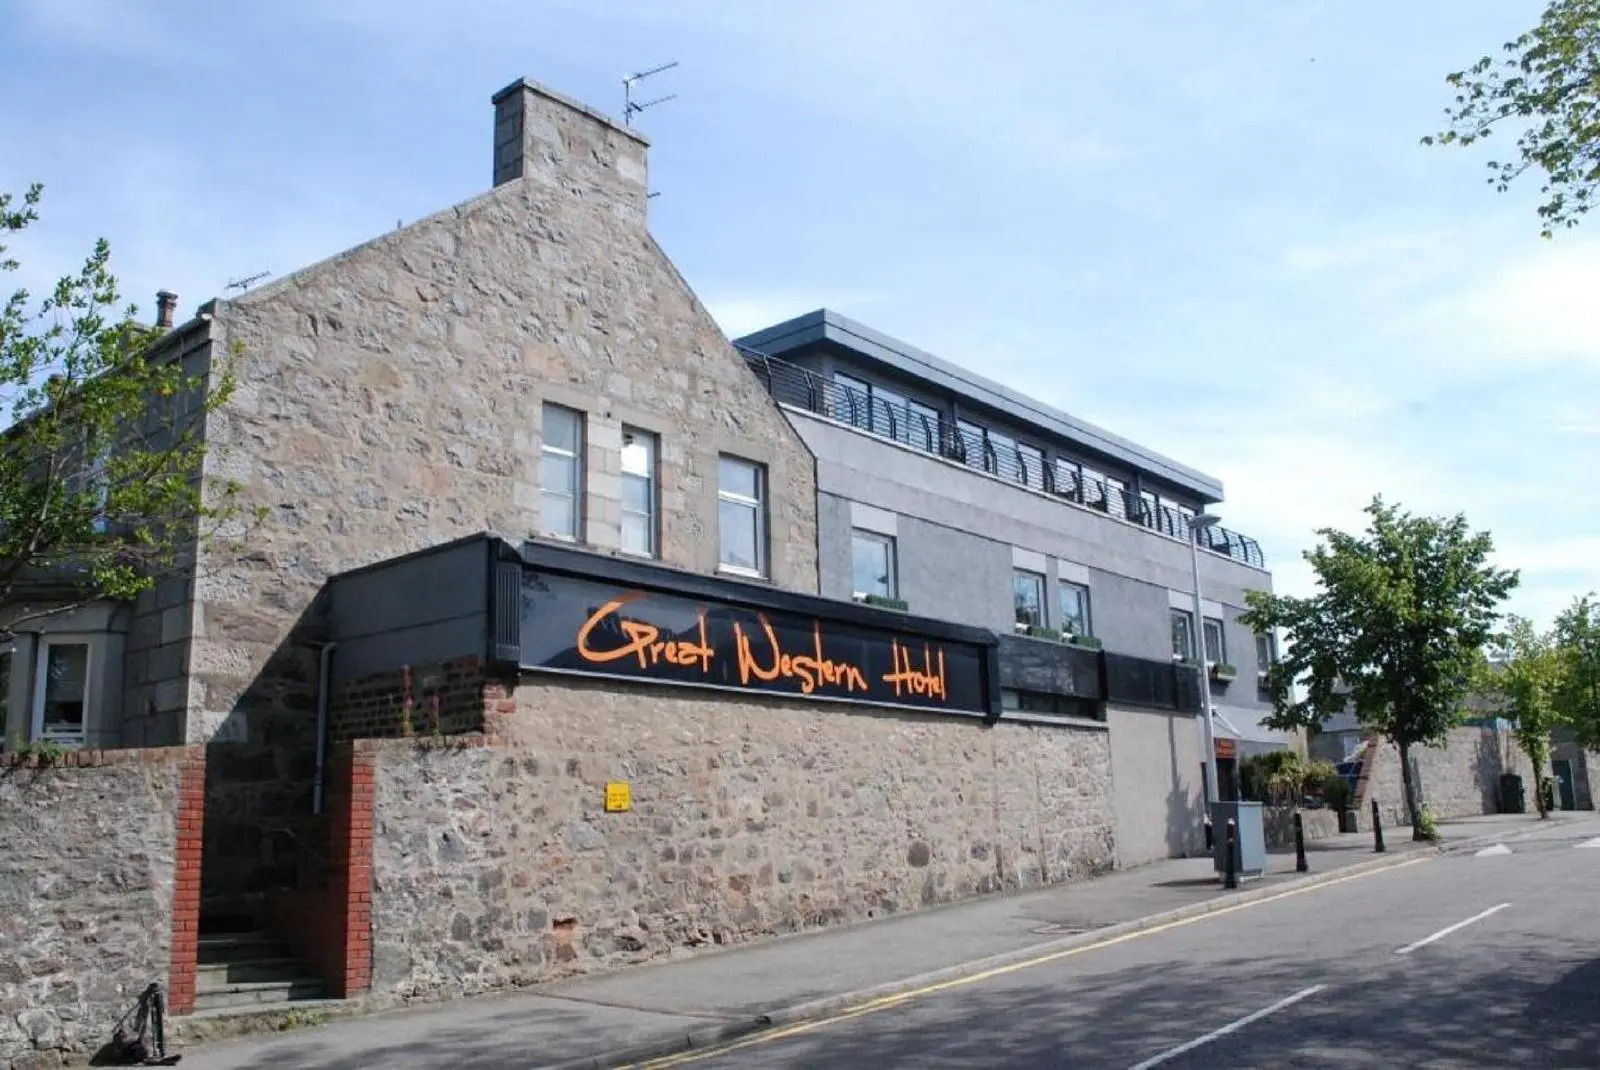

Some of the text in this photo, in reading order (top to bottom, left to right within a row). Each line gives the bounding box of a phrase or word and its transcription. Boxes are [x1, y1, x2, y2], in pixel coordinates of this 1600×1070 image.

[577, 590, 947, 701] Great Western Hotel
